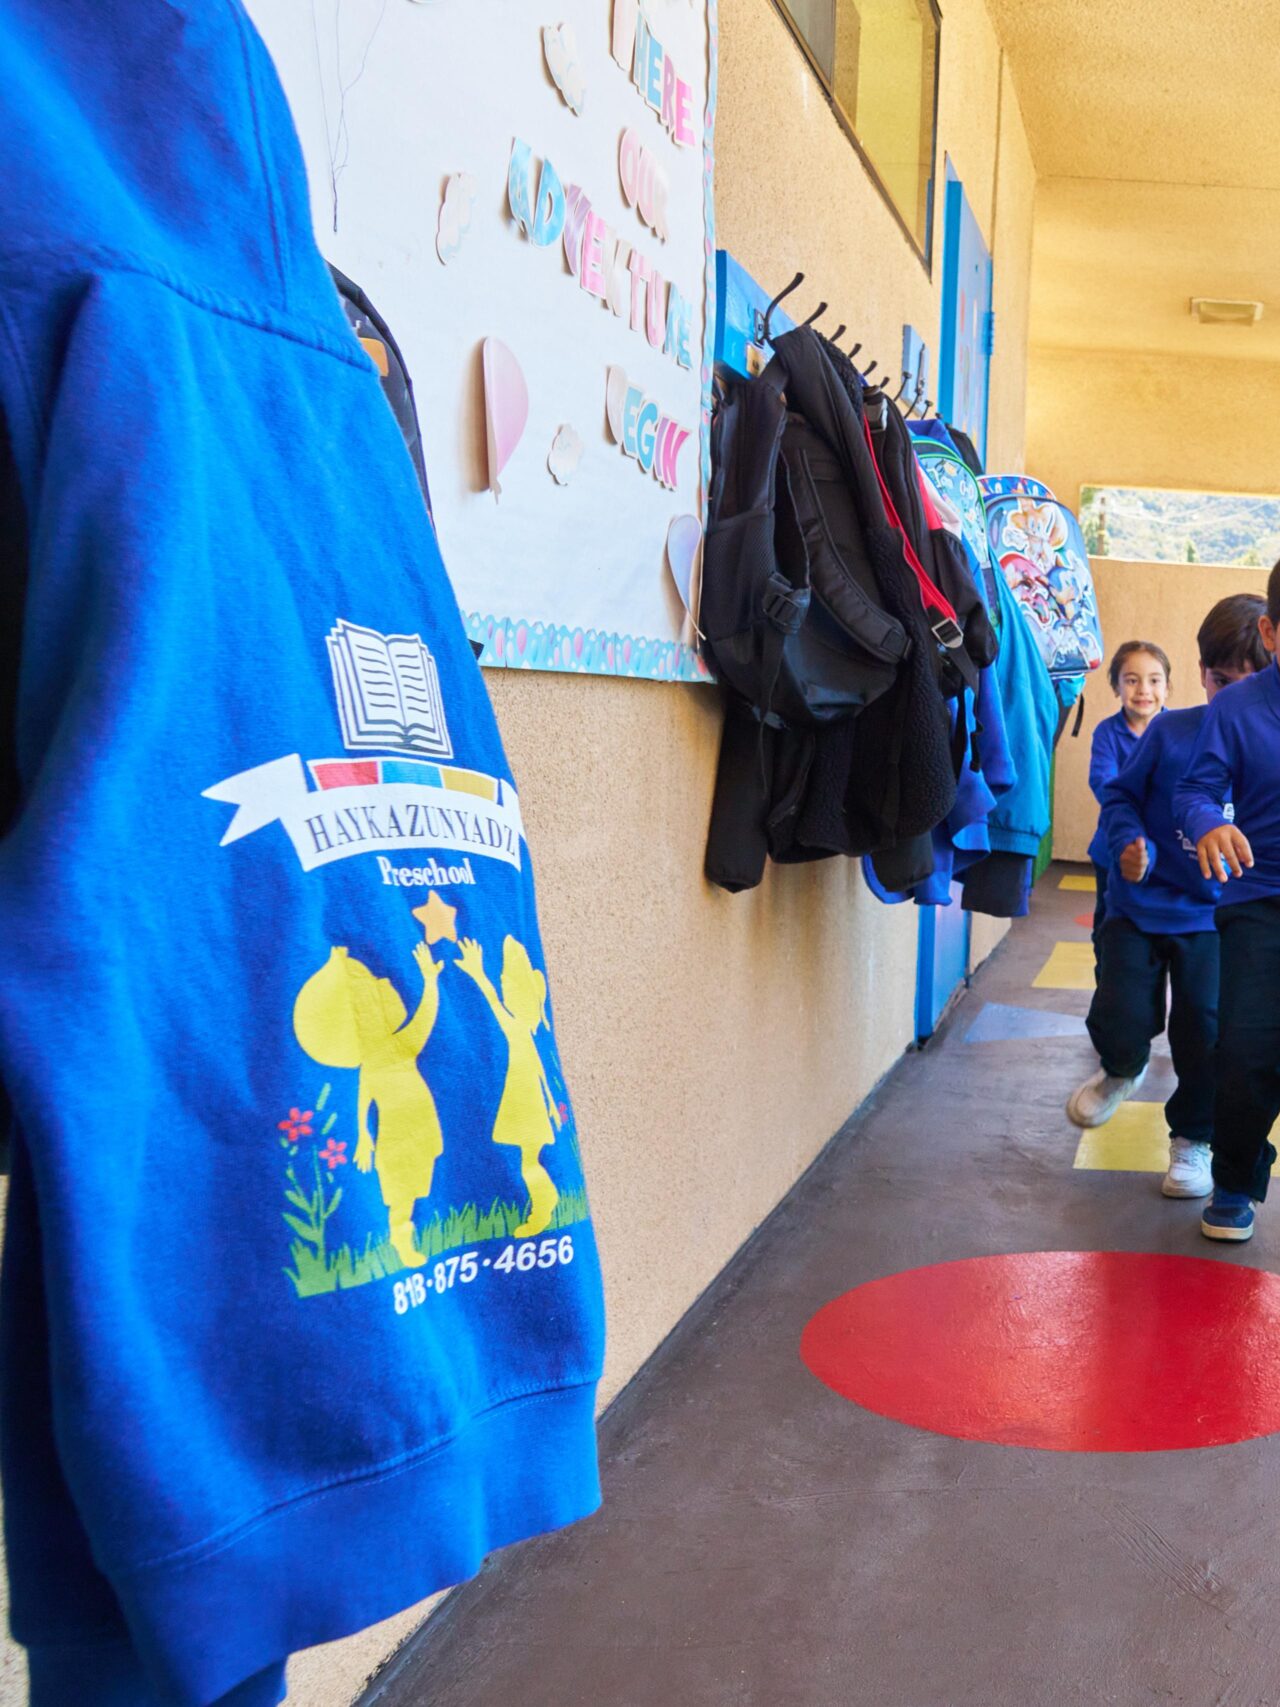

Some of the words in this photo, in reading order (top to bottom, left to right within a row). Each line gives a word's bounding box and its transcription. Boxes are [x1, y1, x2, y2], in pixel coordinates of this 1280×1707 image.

[613, 0, 697, 147] HERE
[508, 137, 693, 369] ADVENTURE
[606, 366, 691, 490] EGIN
[304, 803, 518, 857] HAYKAZUNYADZ
[376, 856, 476, 888] Preschool
